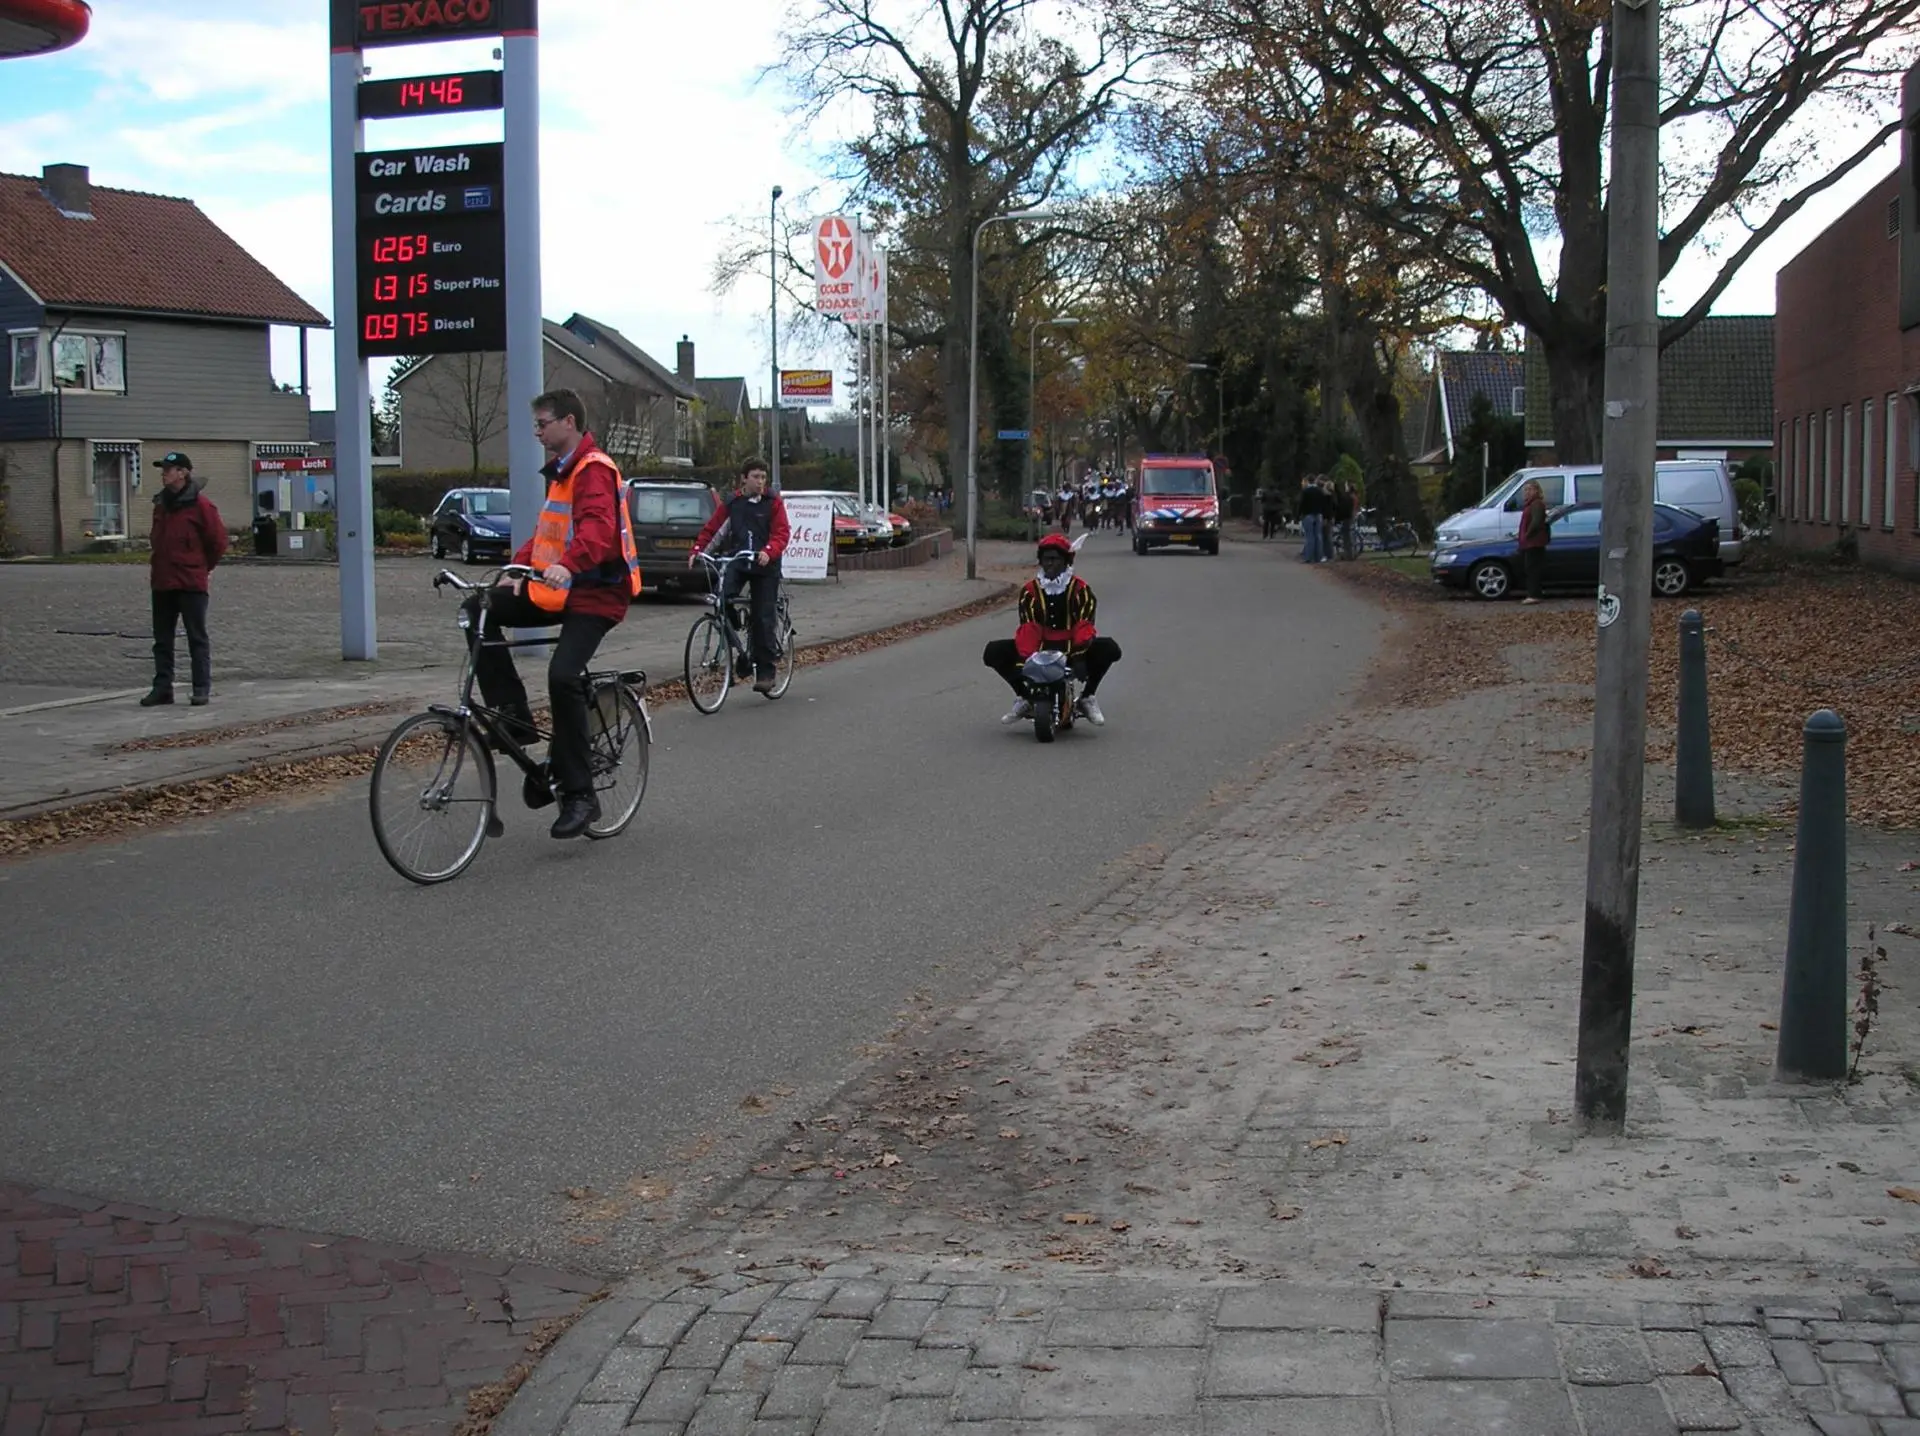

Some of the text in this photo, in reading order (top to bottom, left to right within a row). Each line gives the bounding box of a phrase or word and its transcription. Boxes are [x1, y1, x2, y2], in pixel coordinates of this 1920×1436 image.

[360, 0, 490, 31] TEXACO
[369, 153, 470, 177] Car Wash
[375, 190, 447, 214] Cards
[433, 242, 462, 253] Euro
[434, 279, 471, 291] Super
[473, 277, 500, 288] Plus
[434, 318, 475, 330] Diesel
[260, 459, 327, 470] Water Lucht
[783, 547, 825, 558] KORTING
